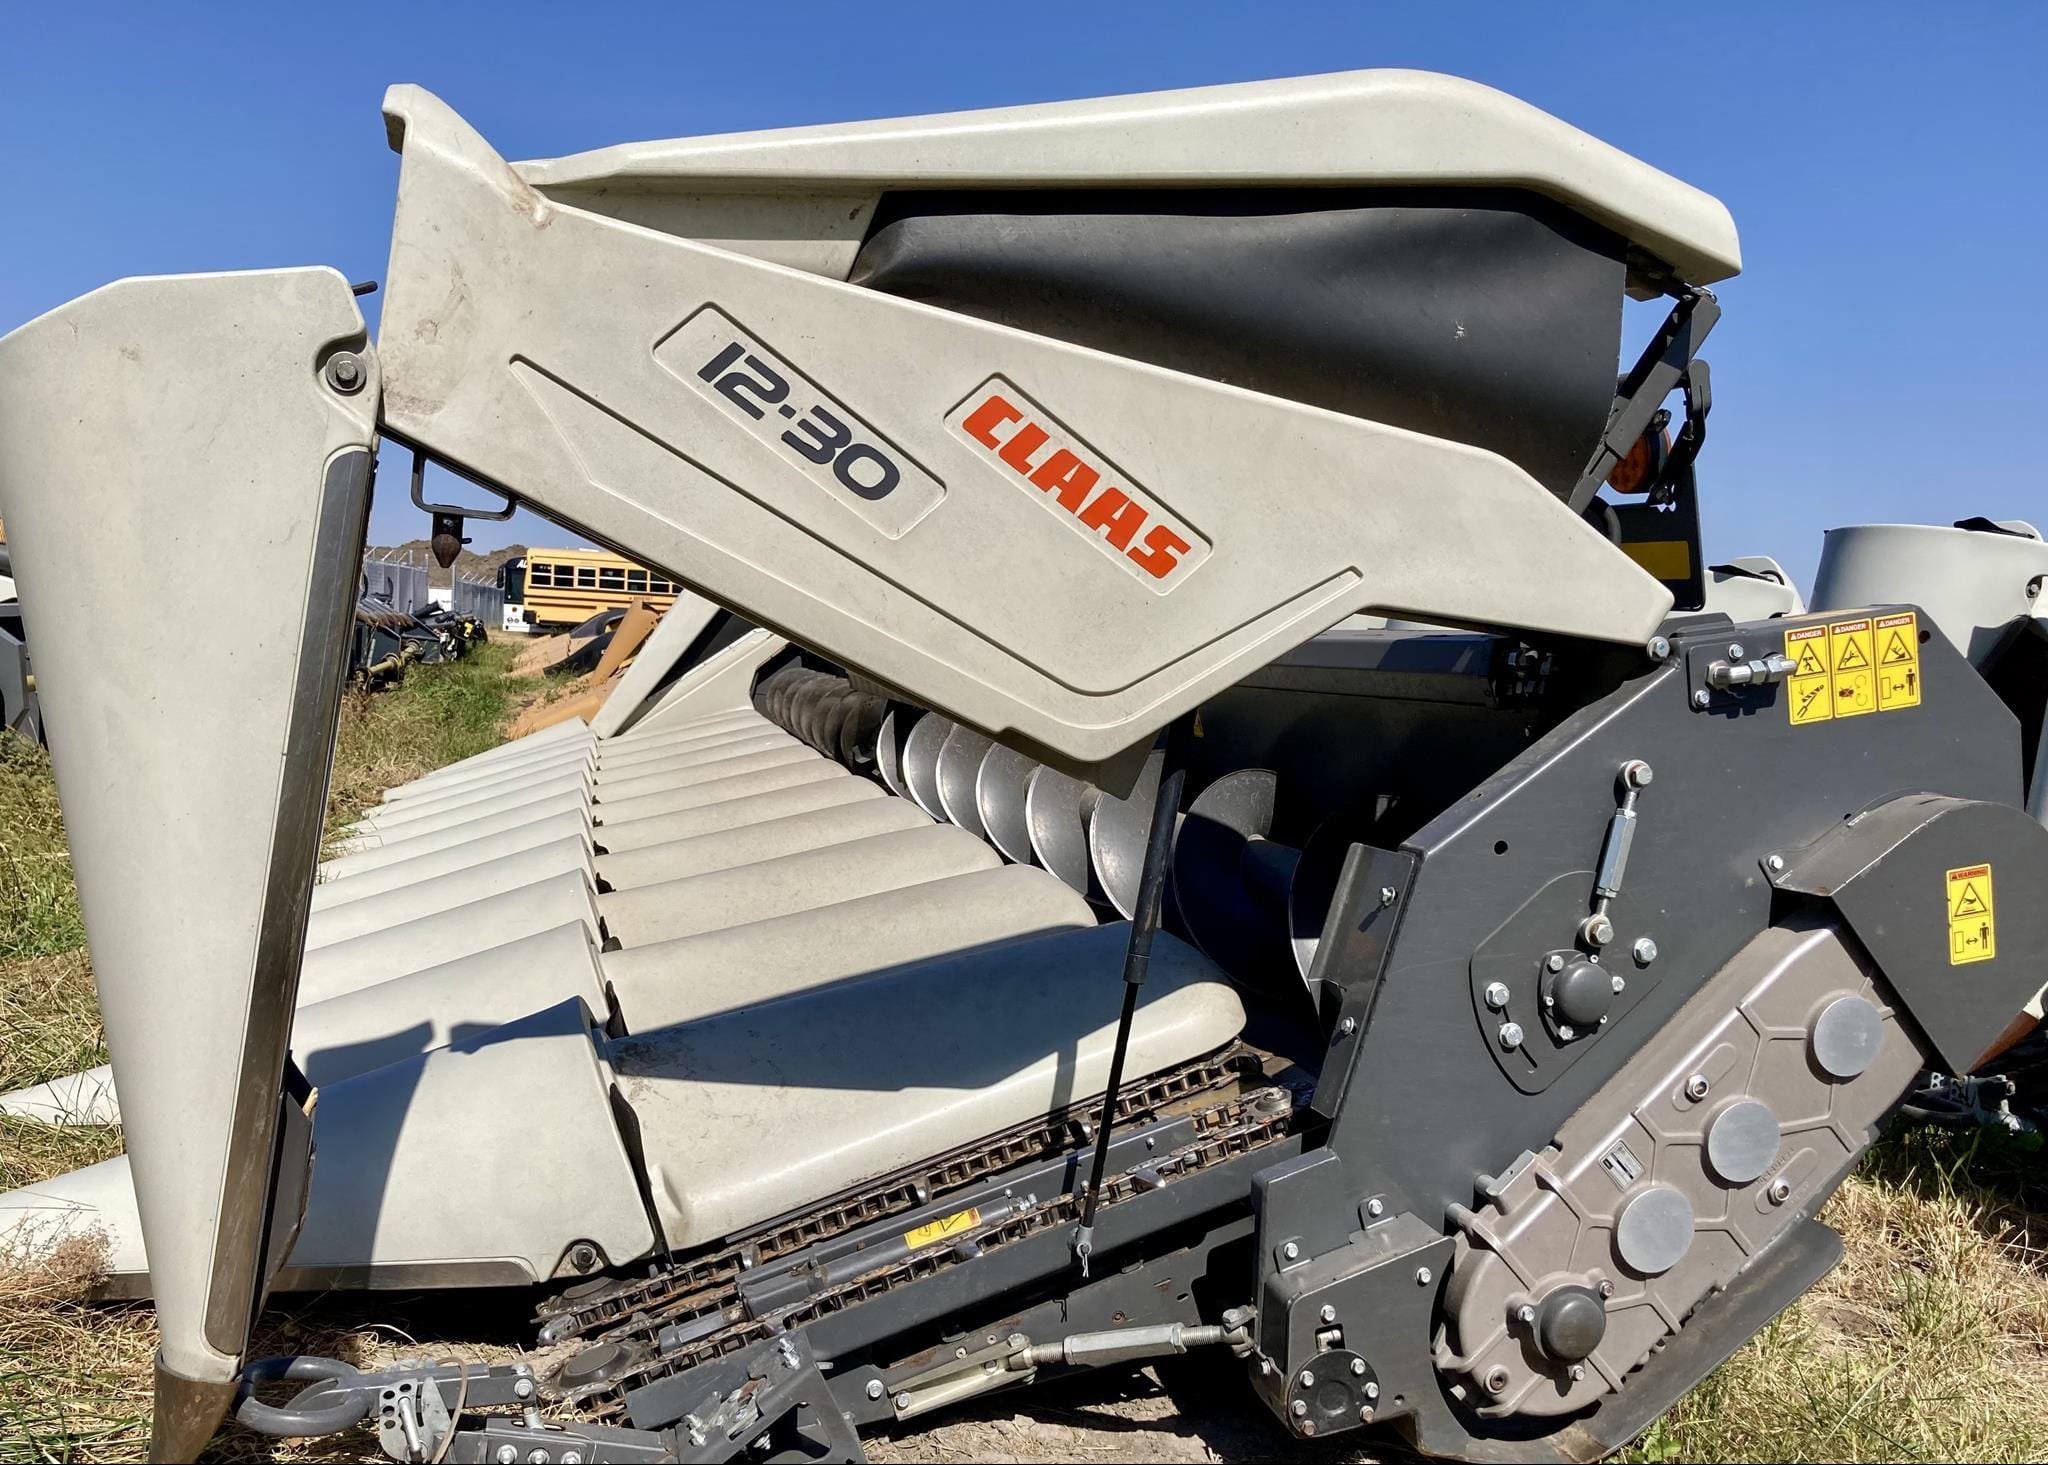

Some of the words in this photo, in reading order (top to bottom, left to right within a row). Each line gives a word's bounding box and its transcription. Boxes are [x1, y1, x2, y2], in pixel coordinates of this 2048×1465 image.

[963, 396, 1190, 578] CLAAS
[1885, 617, 1910, 627] DANGER
[1841, 623, 1866, 632] DANGER
[1796, 629, 1822, 639] DANGER
[1958, 868, 1986, 877] WARNING
